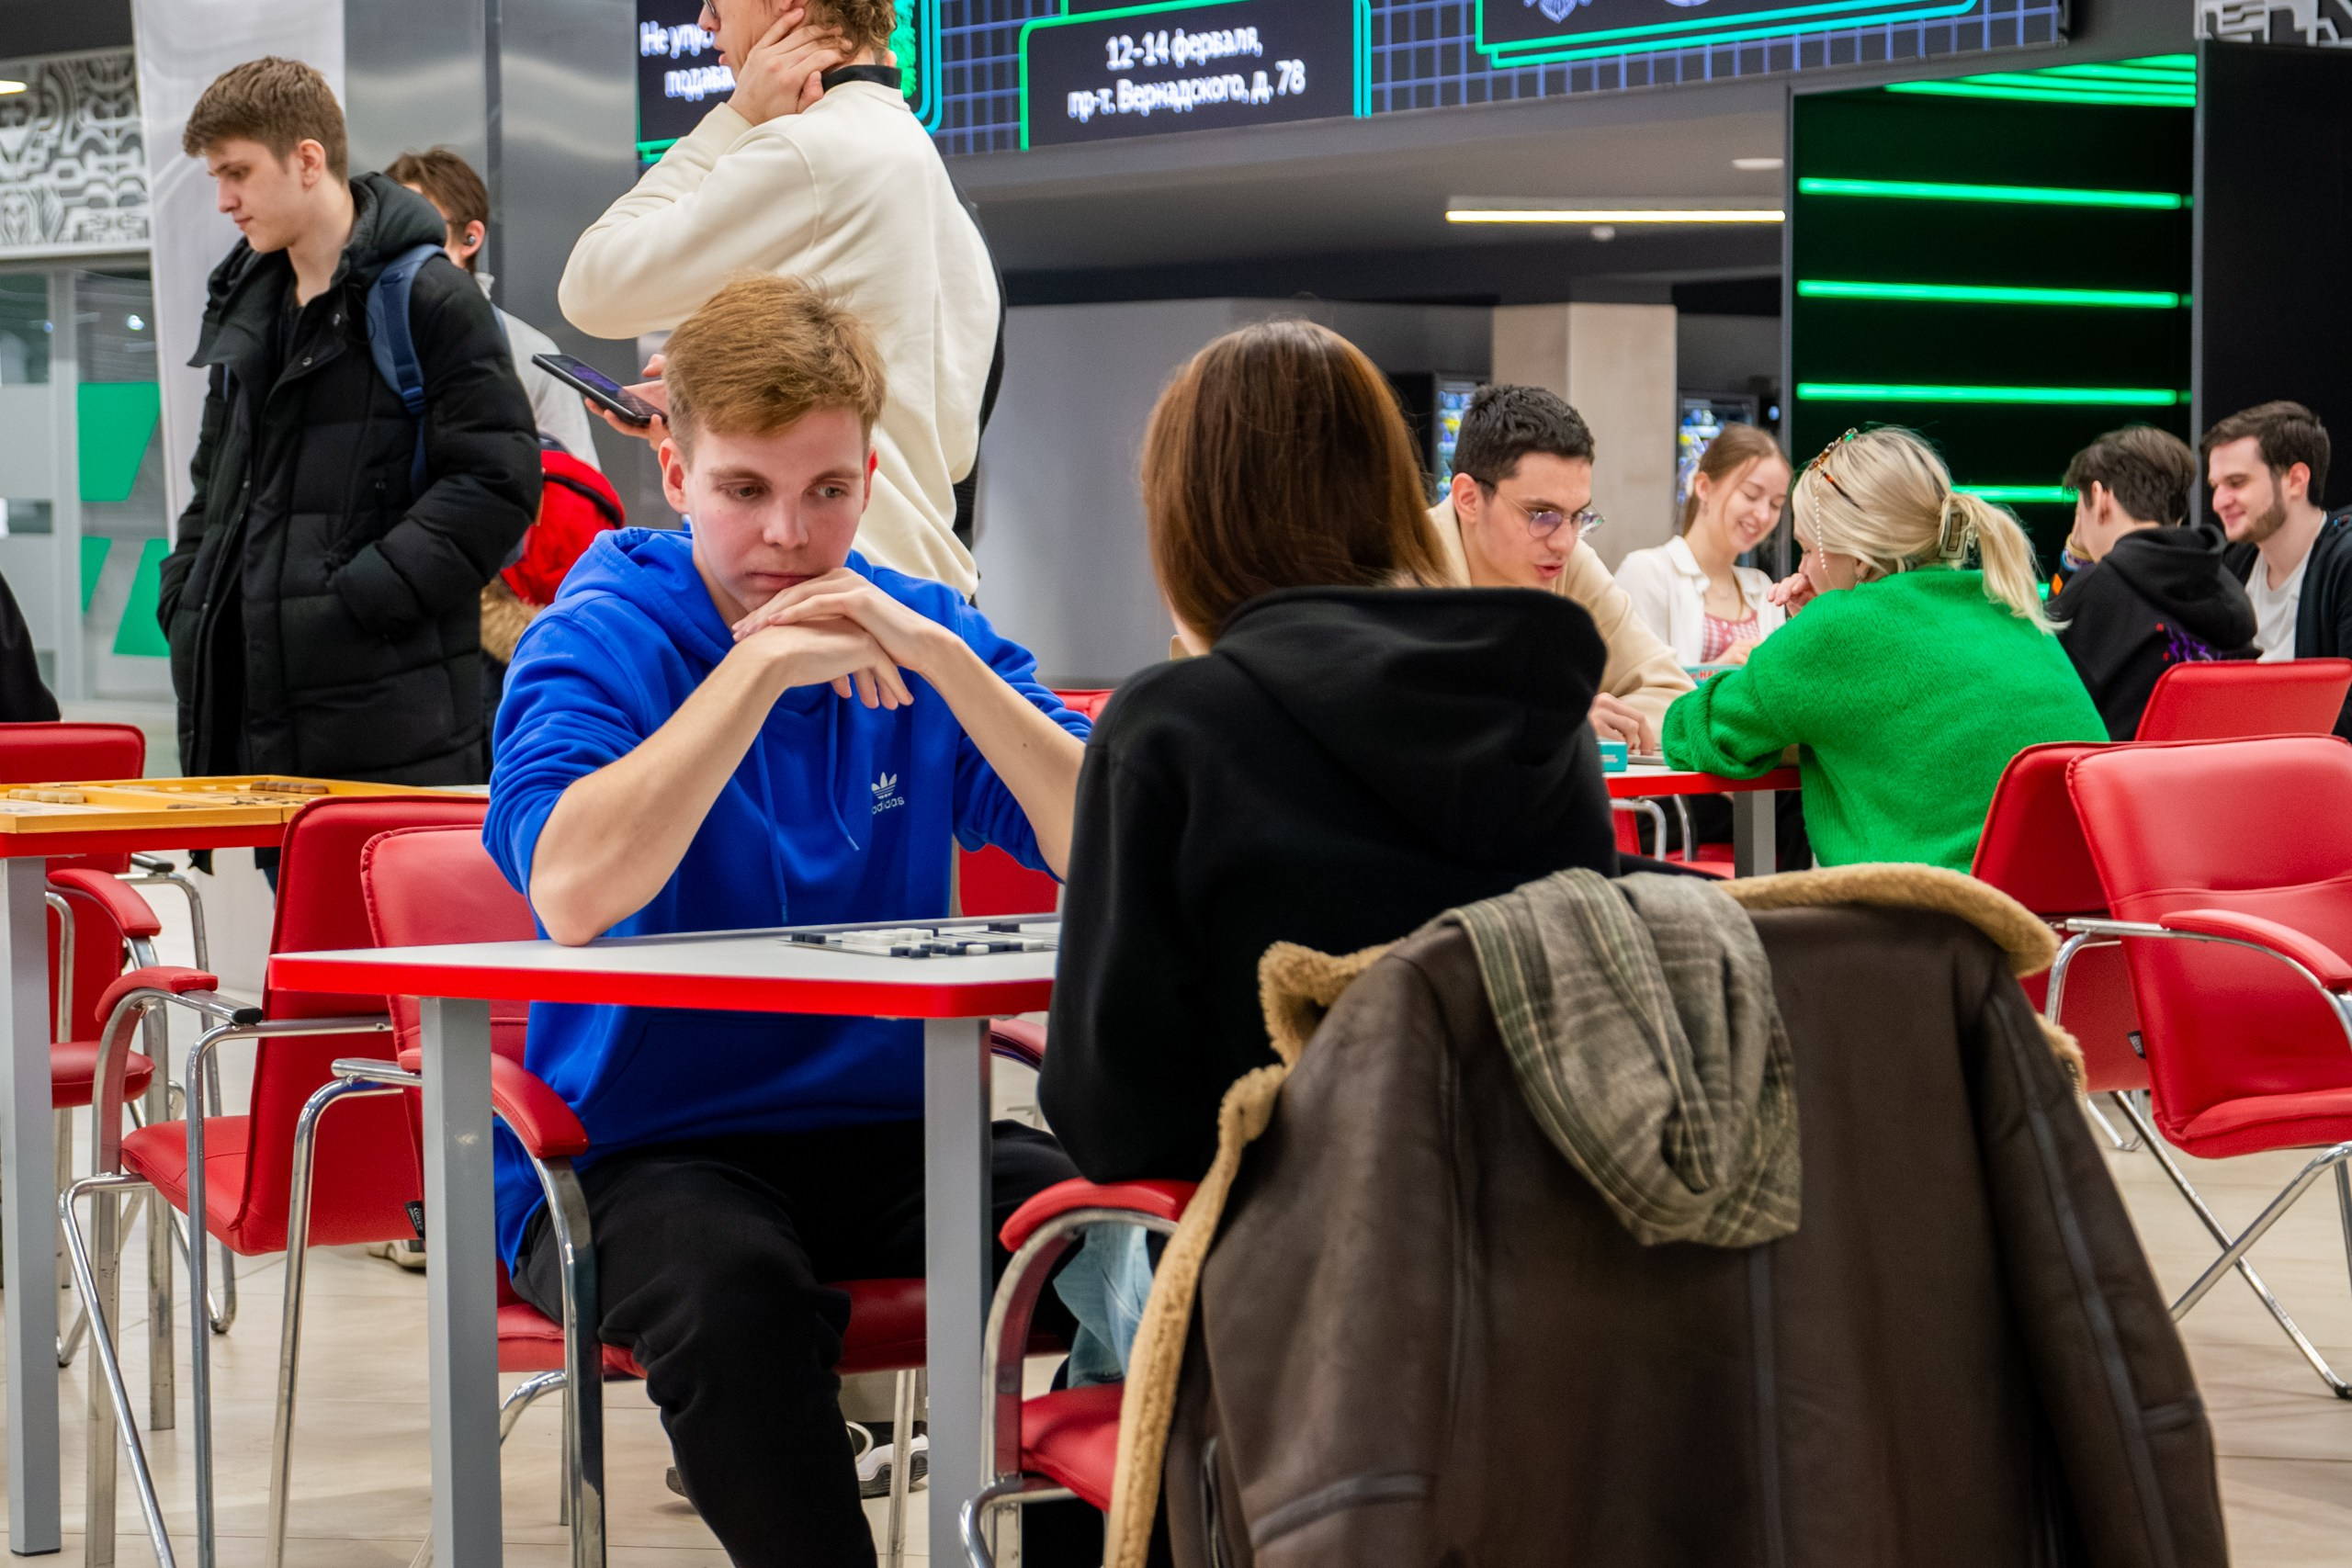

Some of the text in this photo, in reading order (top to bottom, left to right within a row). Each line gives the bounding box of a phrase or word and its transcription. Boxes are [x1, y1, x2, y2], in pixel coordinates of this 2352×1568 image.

[639, 20, 670, 57] Не
[1105, 29, 1170, 72] 12-14
[1116, 73, 1250, 117] Вернадского,
[1275, 58, 1306, 95] 78
